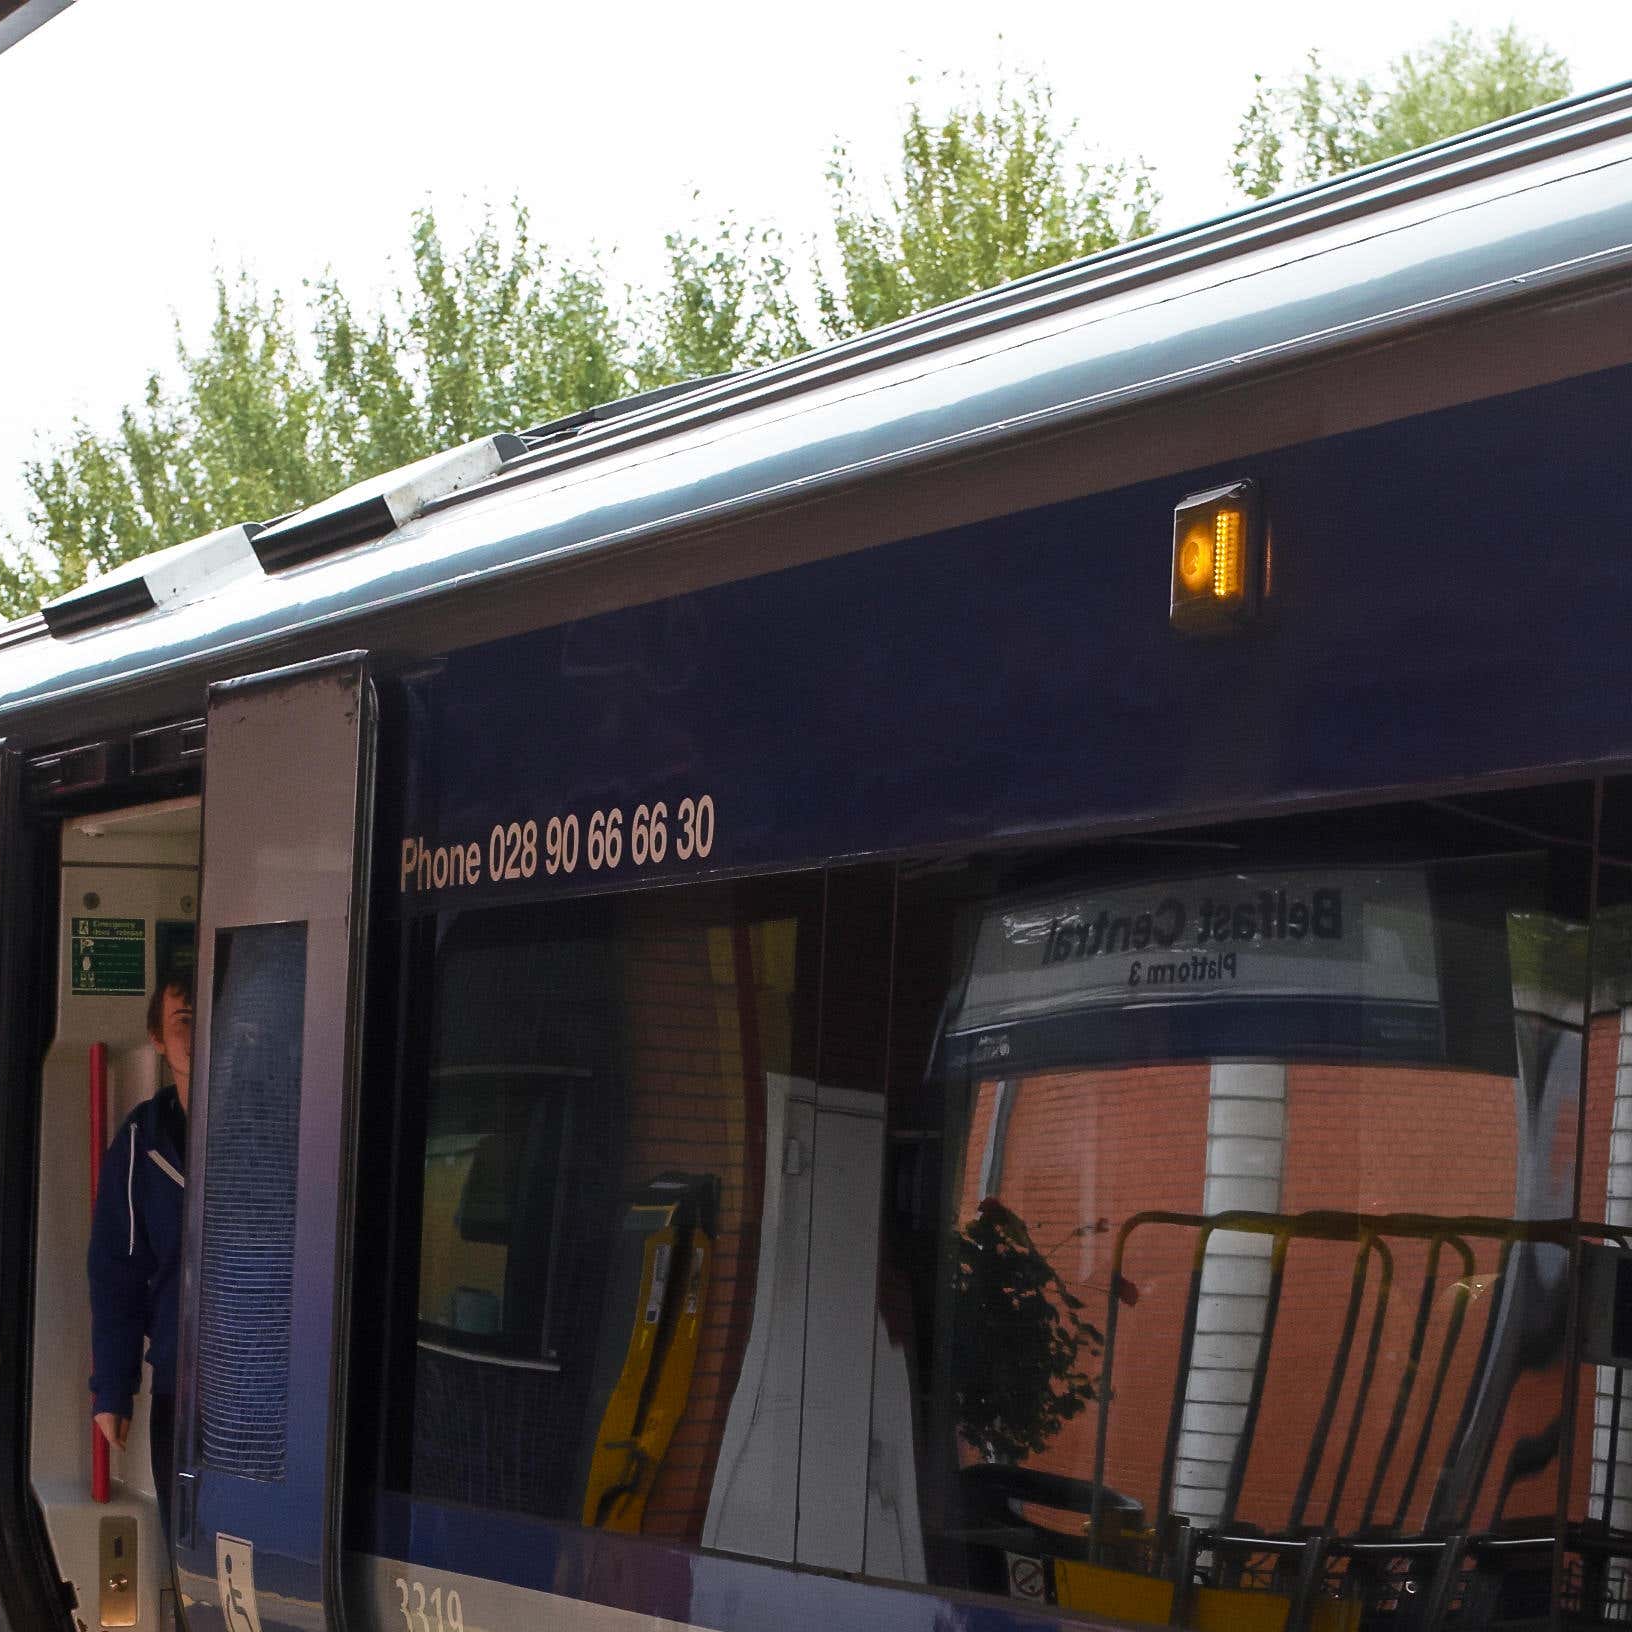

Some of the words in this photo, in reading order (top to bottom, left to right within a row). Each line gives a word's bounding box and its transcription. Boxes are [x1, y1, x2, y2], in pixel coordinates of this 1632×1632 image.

[401, 837, 481, 893] Phone
[489, 824, 538, 882] 028
[546, 814, 580, 875] 90
[588, 808, 623, 870] 66
[632, 802, 668, 865] 66
[676, 795, 715, 860] 30
